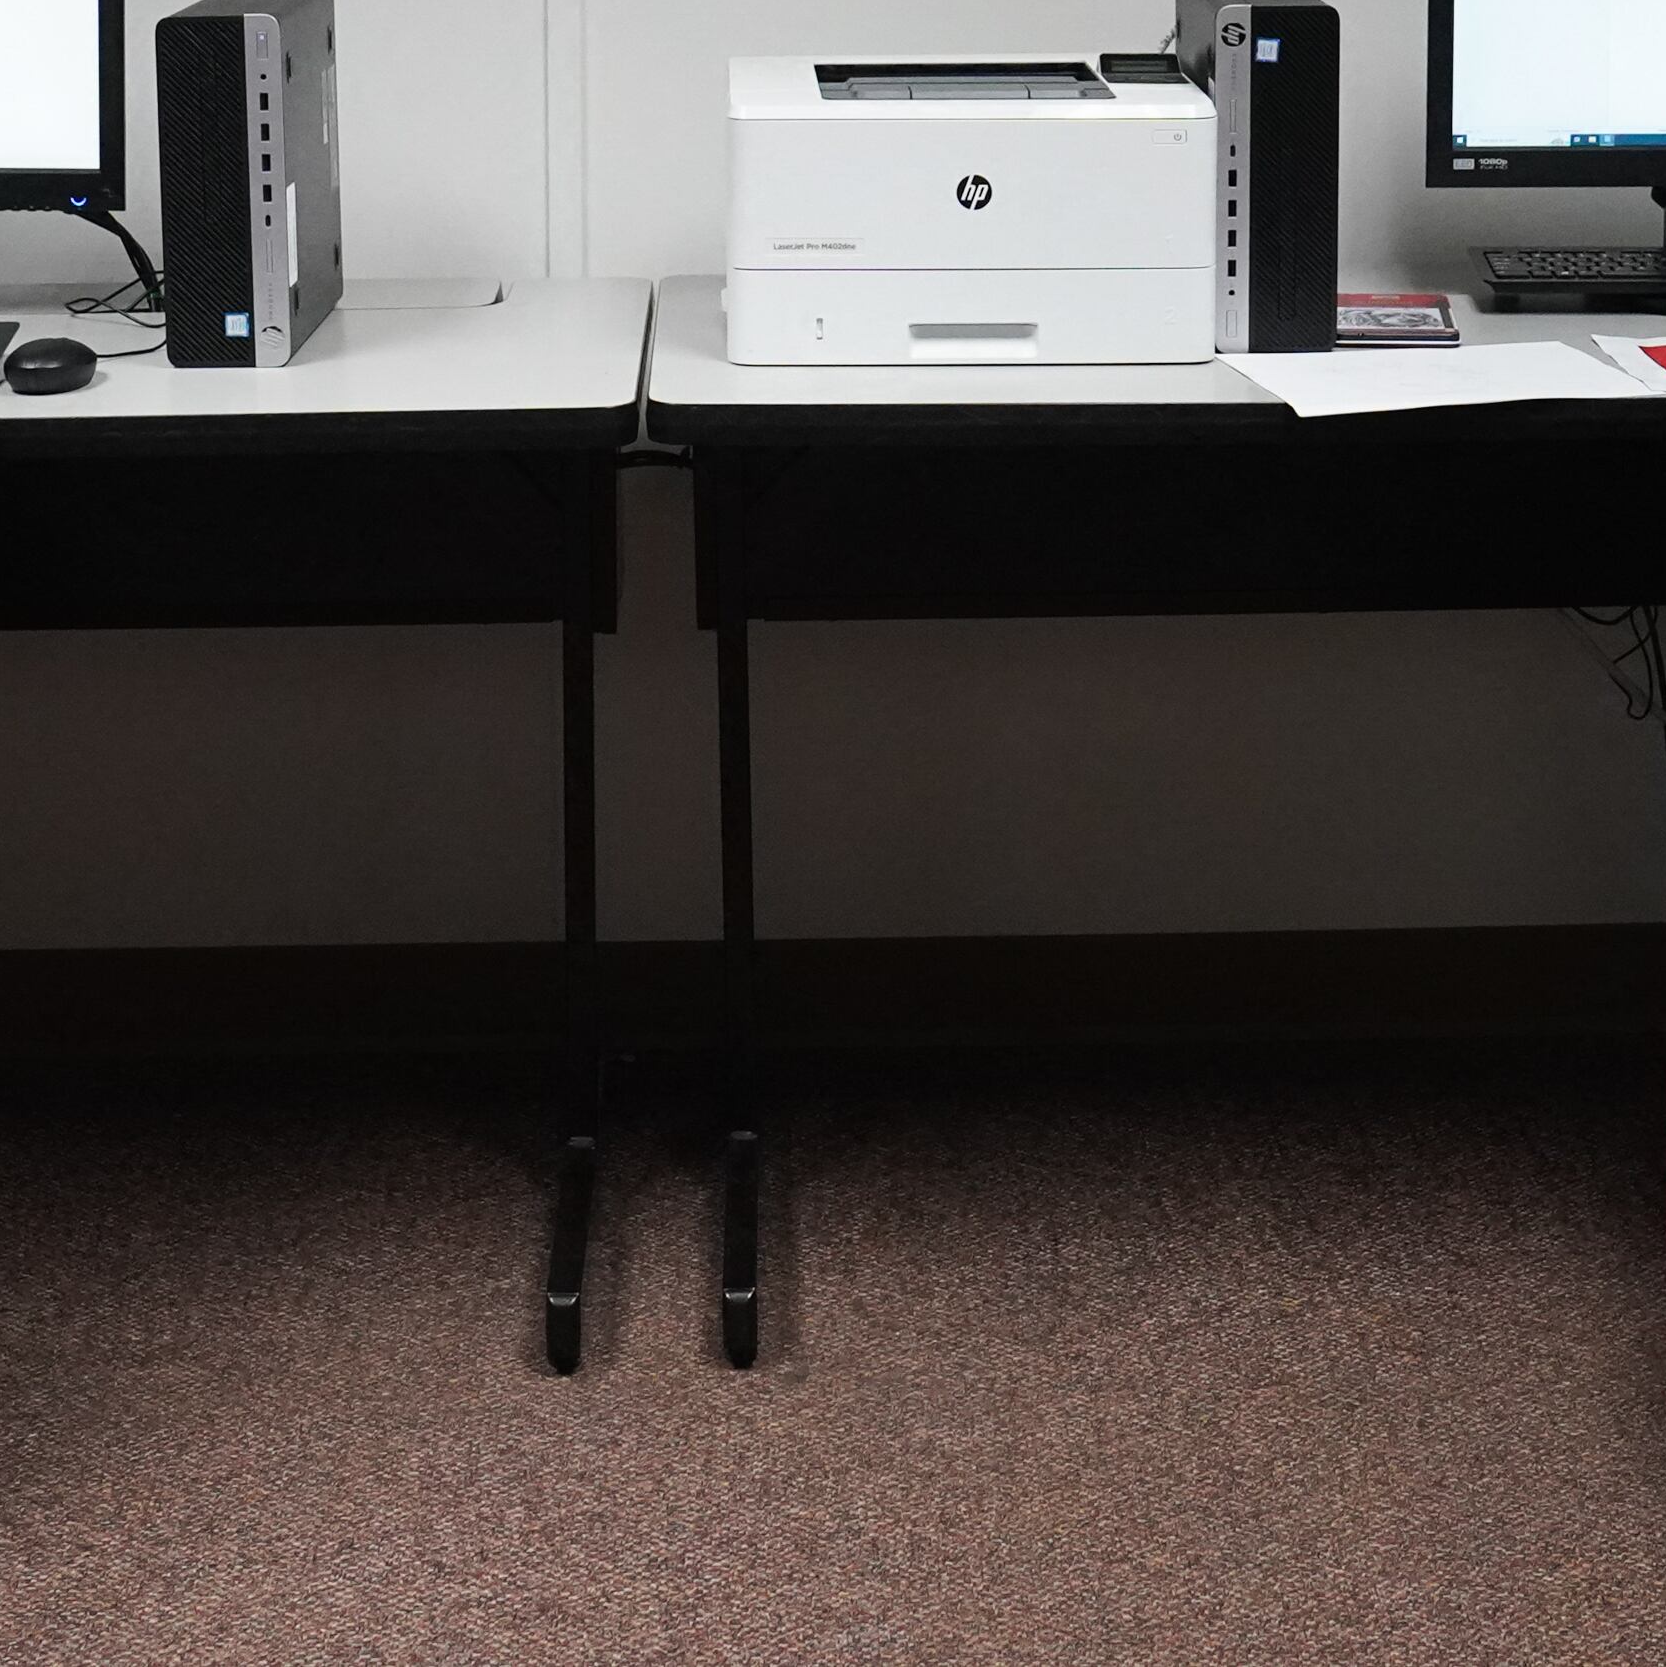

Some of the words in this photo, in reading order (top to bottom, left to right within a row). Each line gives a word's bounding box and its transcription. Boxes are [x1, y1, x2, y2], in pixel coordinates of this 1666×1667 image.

[1478, 158, 1508, 166] 1080p
[957, 174, 992, 210] hp
[773, 242, 805, 251] LaserJet
[806, 242, 820, 251] Pro
